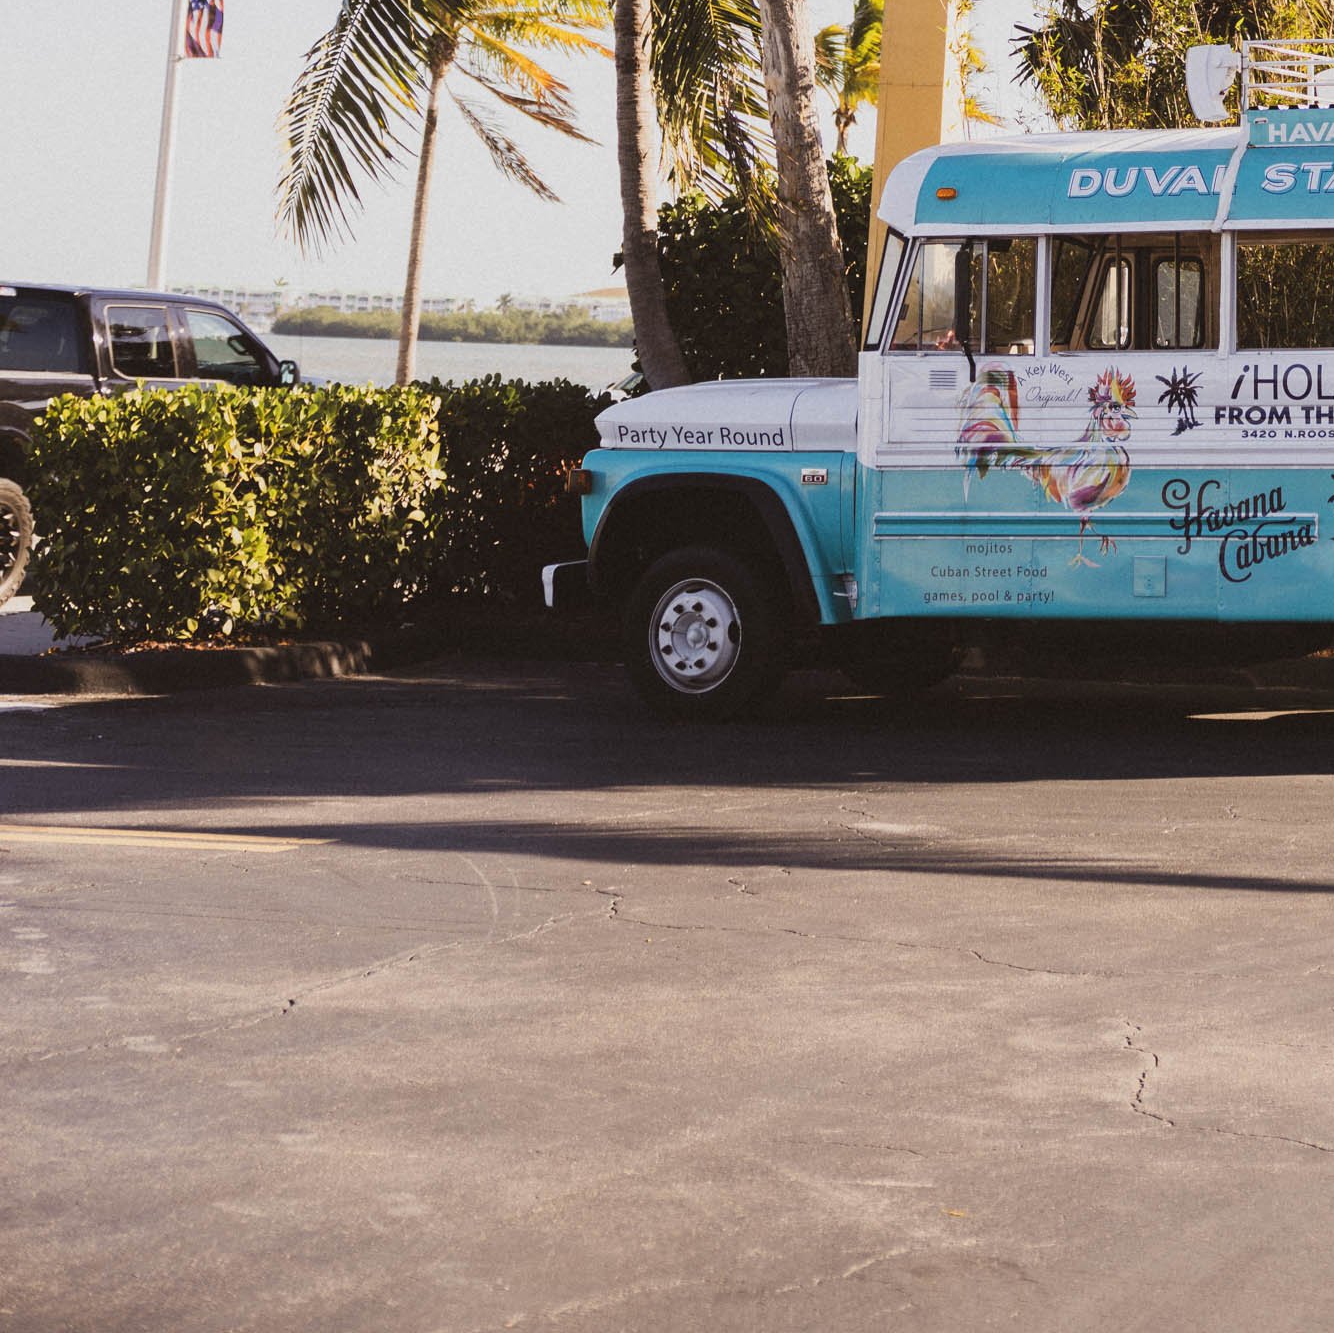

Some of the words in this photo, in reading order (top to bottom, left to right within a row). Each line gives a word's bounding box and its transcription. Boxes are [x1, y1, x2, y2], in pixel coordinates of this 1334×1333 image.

[1016, 376, 1026, 386] A
[1025, 364, 1046, 378] Key
[1049, 363, 1074, 385] West
[1025, 386, 1083, 408] Original!
[1214, 405, 1292, 425] FROM
[618, 425, 667, 449] Party
[671, 425, 714, 445] Year
[720, 427, 785, 446] Round
[1241, 429, 1277, 439] 3420
[1161, 478, 1287, 555] Havana
[966, 542, 1013, 556] mojitos
[1218, 517, 1317, 583] Cabana
[930, 565, 970, 578] Cuban
[975, 566, 1011, 578] Street
[1016, 566, 1048, 578] Food
[923, 591, 967, 604] games,
[971, 590, 999, 604] pool
[1003, 590, 1012, 602] &
[1016, 590, 1055, 604] party!
